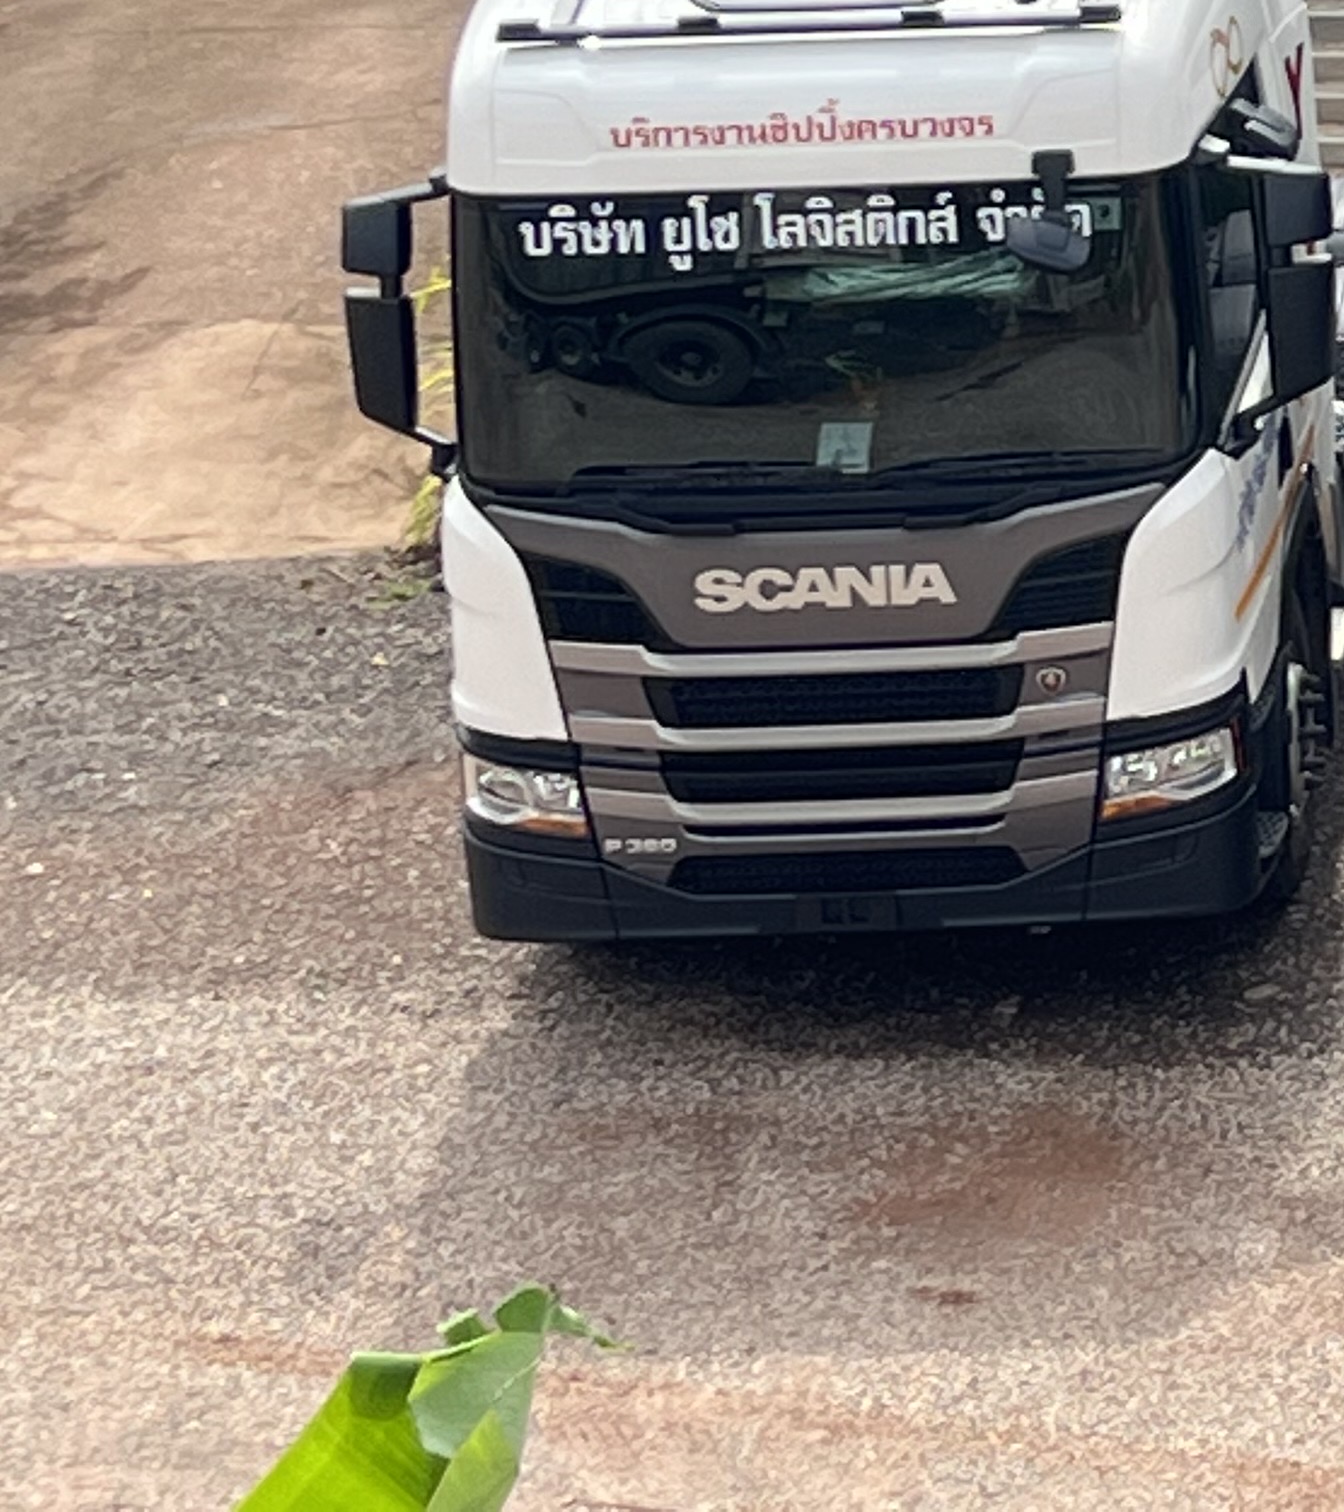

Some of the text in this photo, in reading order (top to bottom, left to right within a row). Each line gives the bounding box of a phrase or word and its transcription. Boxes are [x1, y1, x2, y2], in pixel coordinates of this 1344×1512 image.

[517, 201, 646, 257] บริษัท
[753, 190, 959, 250] โลจิสติกส์
[693, 562, 959, 613] SCANIA
